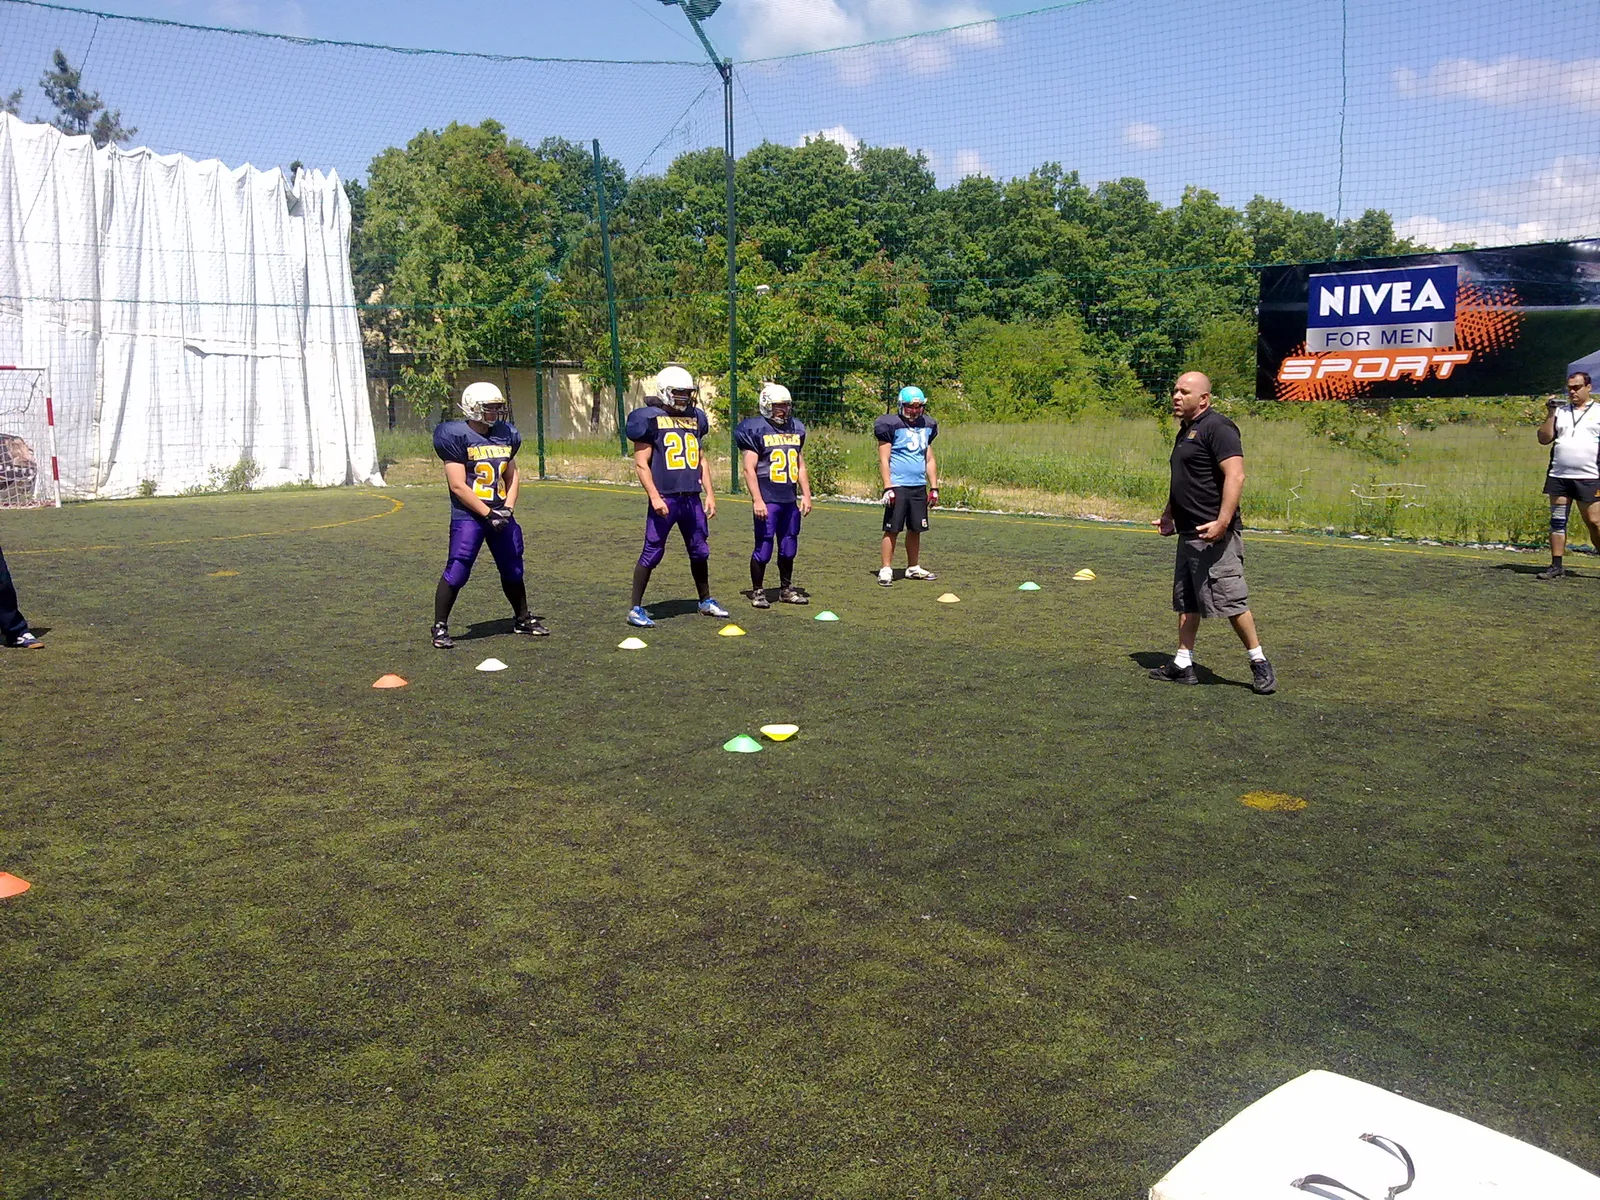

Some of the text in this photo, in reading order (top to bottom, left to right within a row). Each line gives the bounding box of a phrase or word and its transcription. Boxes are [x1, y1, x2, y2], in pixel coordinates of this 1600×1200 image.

[1319, 278, 1446, 317] NIVEA
[1325, 327, 1433, 347] FOR MEN
[1280, 353, 1469, 380] SPORT
[663, 431, 699, 470] 28
[769, 448, 799, 484] 28
